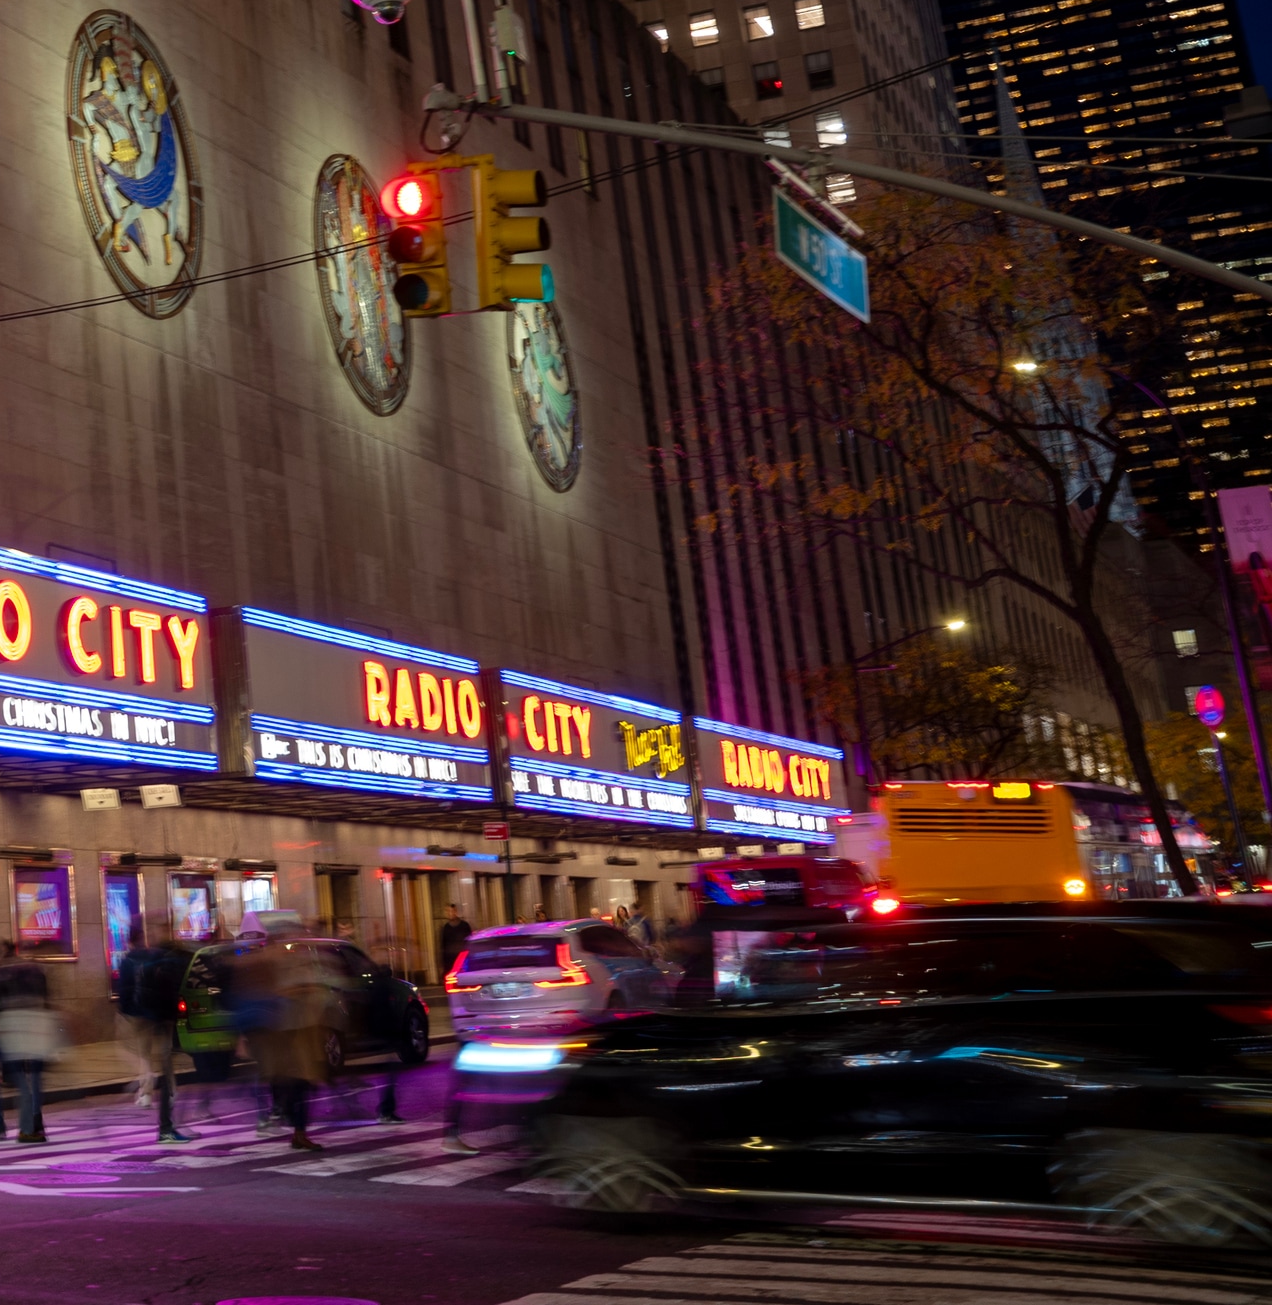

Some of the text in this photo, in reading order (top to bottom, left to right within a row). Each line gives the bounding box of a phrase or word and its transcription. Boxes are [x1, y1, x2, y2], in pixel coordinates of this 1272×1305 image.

[65, 595, 201, 691] CITY
[3, 697, 104, 737] CHRISTMAS
[110, 712, 130, 740] IN
[364, 660, 482, 739] RADIO
[523, 694, 591, 759] CITY
[296, 739, 327, 767] THIS
[329, 744, 344, 769] IS
[720, 739, 831, 801] RADIO CITY
